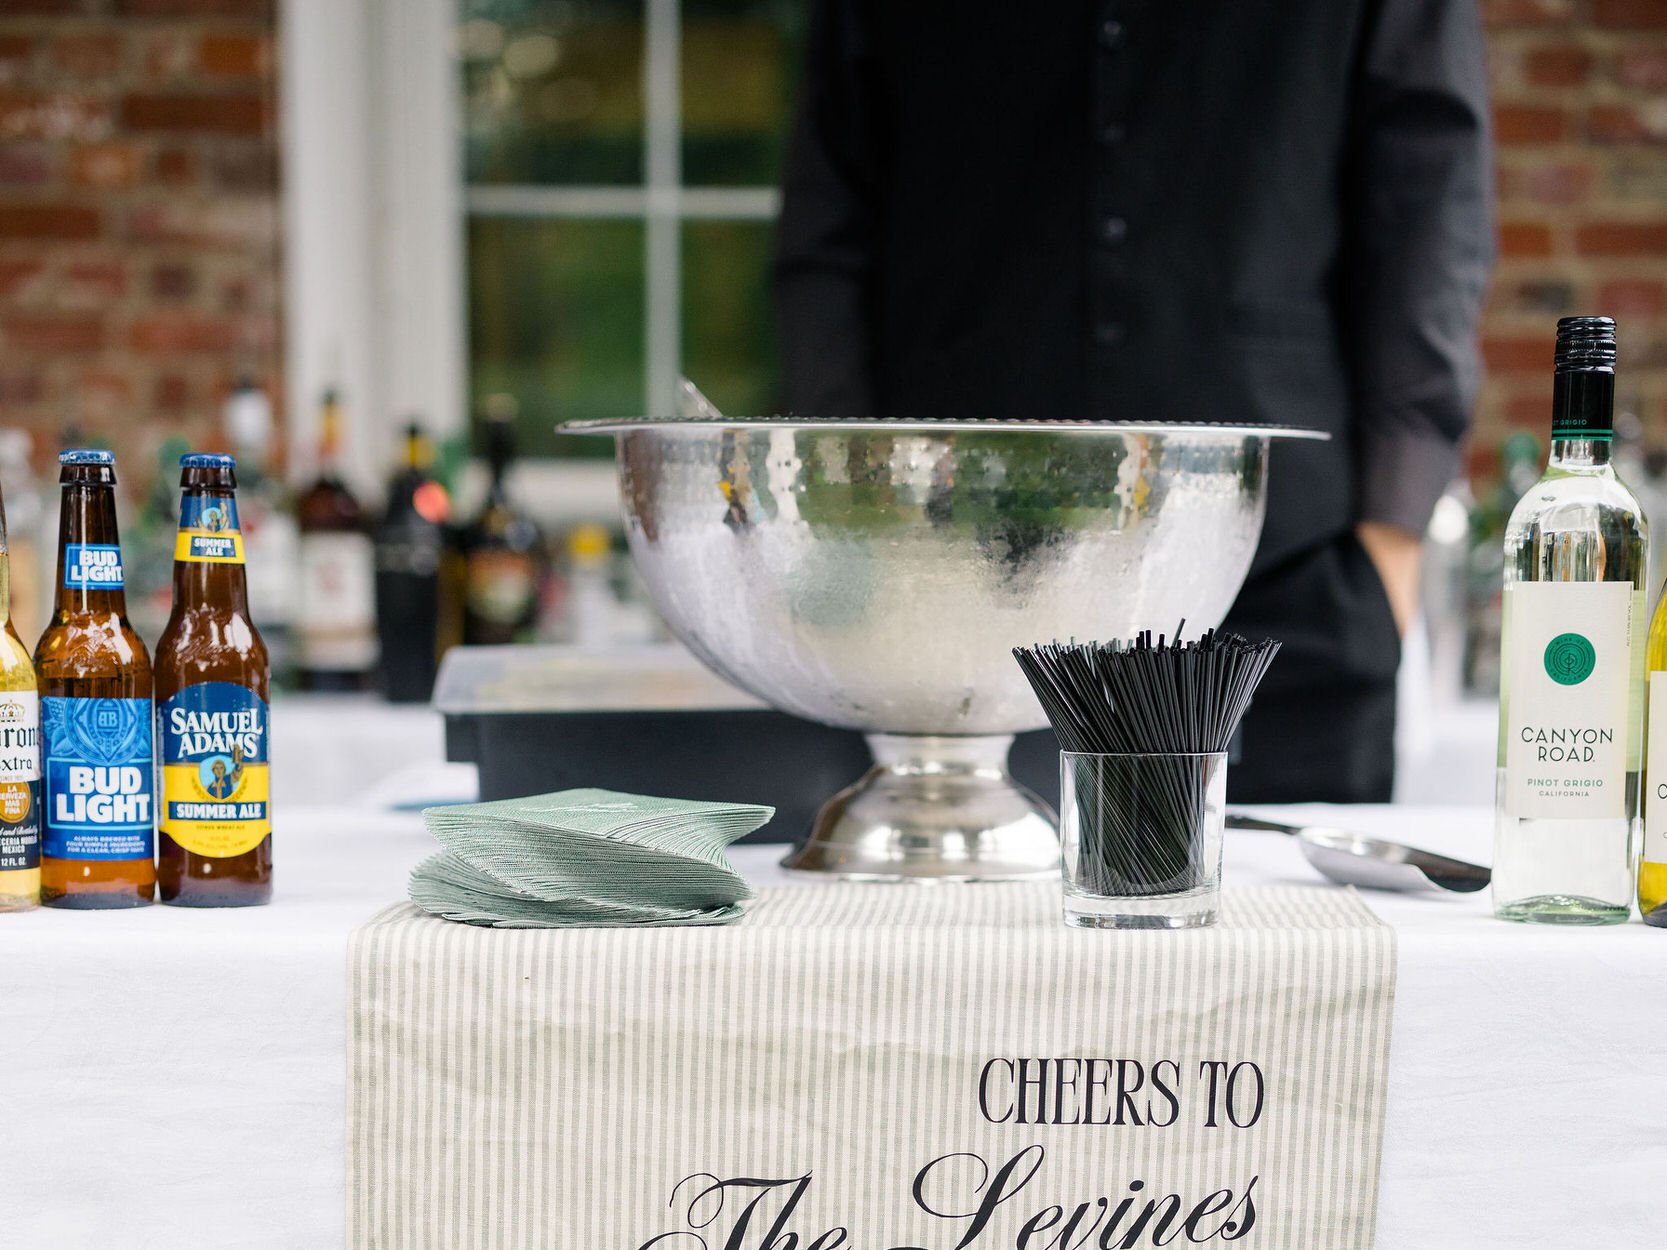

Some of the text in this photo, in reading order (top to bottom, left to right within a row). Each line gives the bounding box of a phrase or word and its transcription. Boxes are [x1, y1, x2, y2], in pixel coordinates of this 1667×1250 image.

[194, 537, 231, 549] SUMMER
[206, 547, 223, 556] ALE
[79, 550, 118, 567] BUD
[71, 565, 123, 582] LIGHT
[170, 707, 263, 735] SAMUEL
[1521, 727, 1613, 745] CANYON
[177, 732, 258, 759] ADAMS
[0, 757, 32, 771] xtra
[69, 766, 142, 795] BUD
[1527, 778, 1604, 788] PINOT GRIGIO
[56, 793, 151, 824] LIGHT
[176, 803, 262, 819] SUMMER ALE
[1, 857, 8, 867] 12
[978, 1057, 1265, 1129] CHEERS TO
